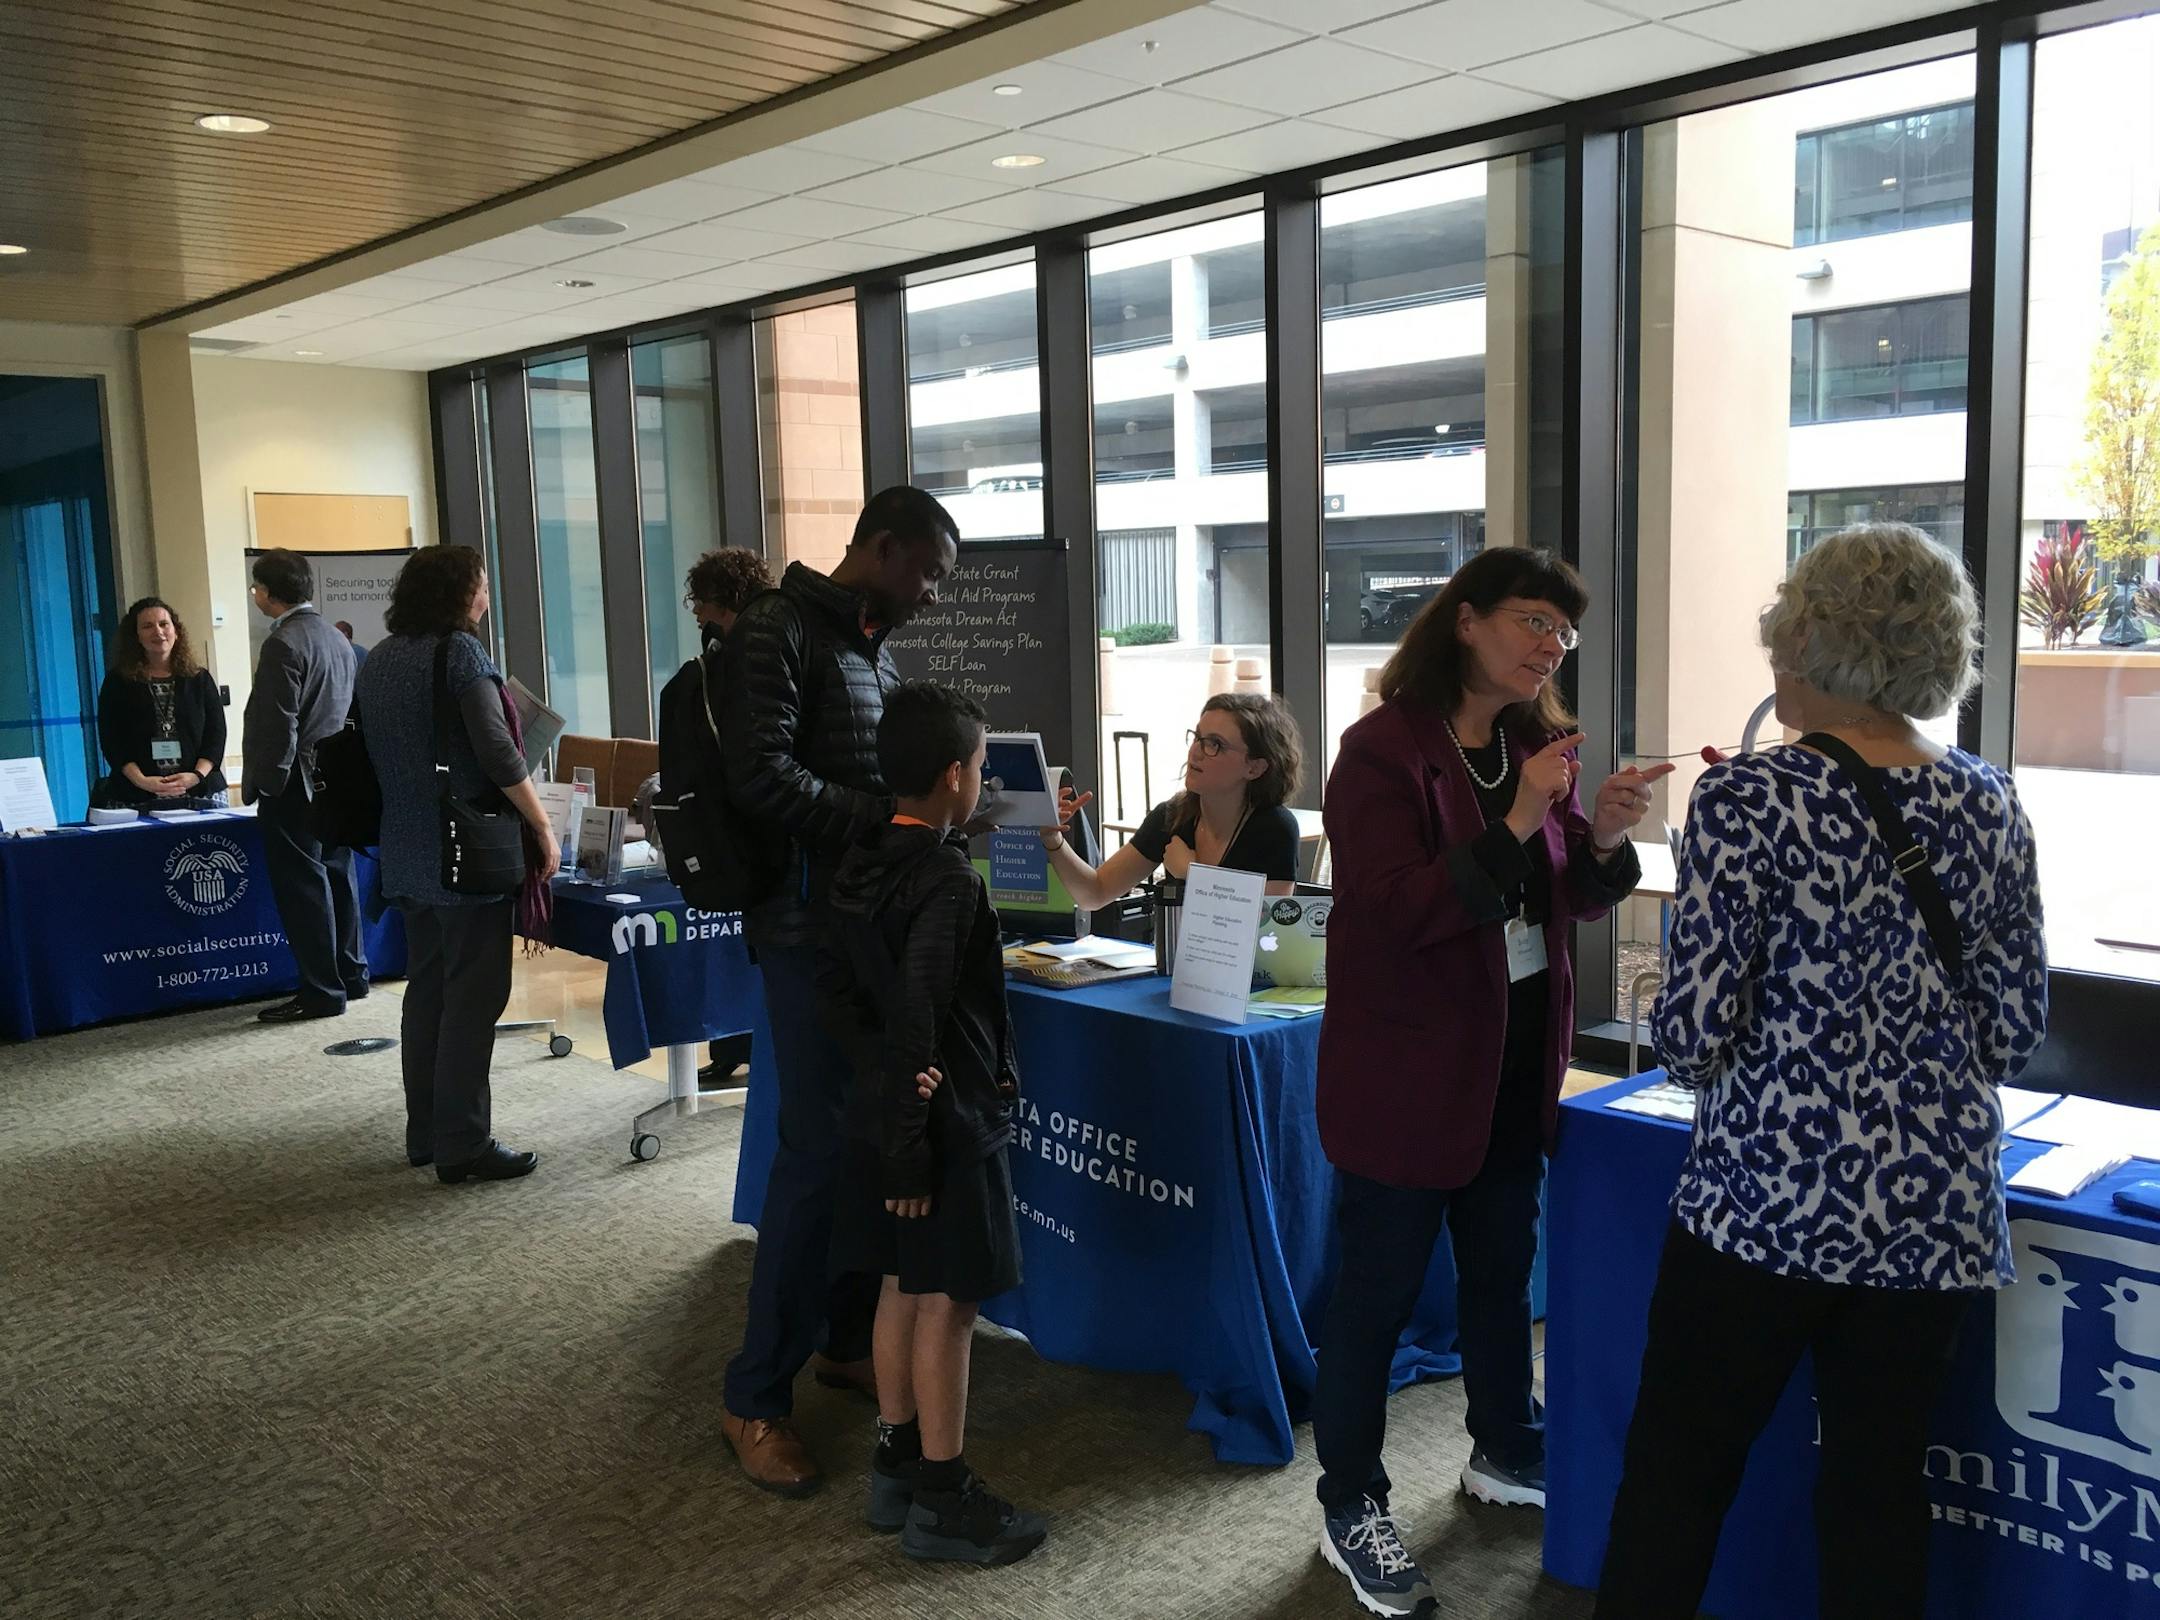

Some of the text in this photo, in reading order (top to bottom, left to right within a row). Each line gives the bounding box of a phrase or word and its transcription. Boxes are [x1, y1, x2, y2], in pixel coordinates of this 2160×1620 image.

[326, 578, 374, 589] Securing
[952, 564, 1019, 581] State Grant
[327, 592, 348, 601] and
[961, 587, 980, 603] Aid
[982, 587, 1036, 609] Programs
[955, 611, 993, 626] Dream
[997, 609, 1017, 626] Act
[931, 632, 969, 656] College
[973, 633, 1014, 656] Savings
[1017, 633, 1042, 649] Plan
[928, 656, 986, 671] SELF Loan
[963, 678, 1011, 700] Program
[163, 833, 249, 874] SOCIAL SECURITY
[192, 869, 224, 882] USA
[164, 877, 249, 916] ADMINISTRATION
[103, 931, 290, 964] www.socialsecurity.
[156, 961, 268, 988] 1-800-772-1213
[1050, 1111, 1137, 1162] OFFICE
[1041, 1136, 1194, 1208] EDUCATION
[2079, 1543, 2114, 1571] IS
[2125, 1562, 2160, 1590] P
